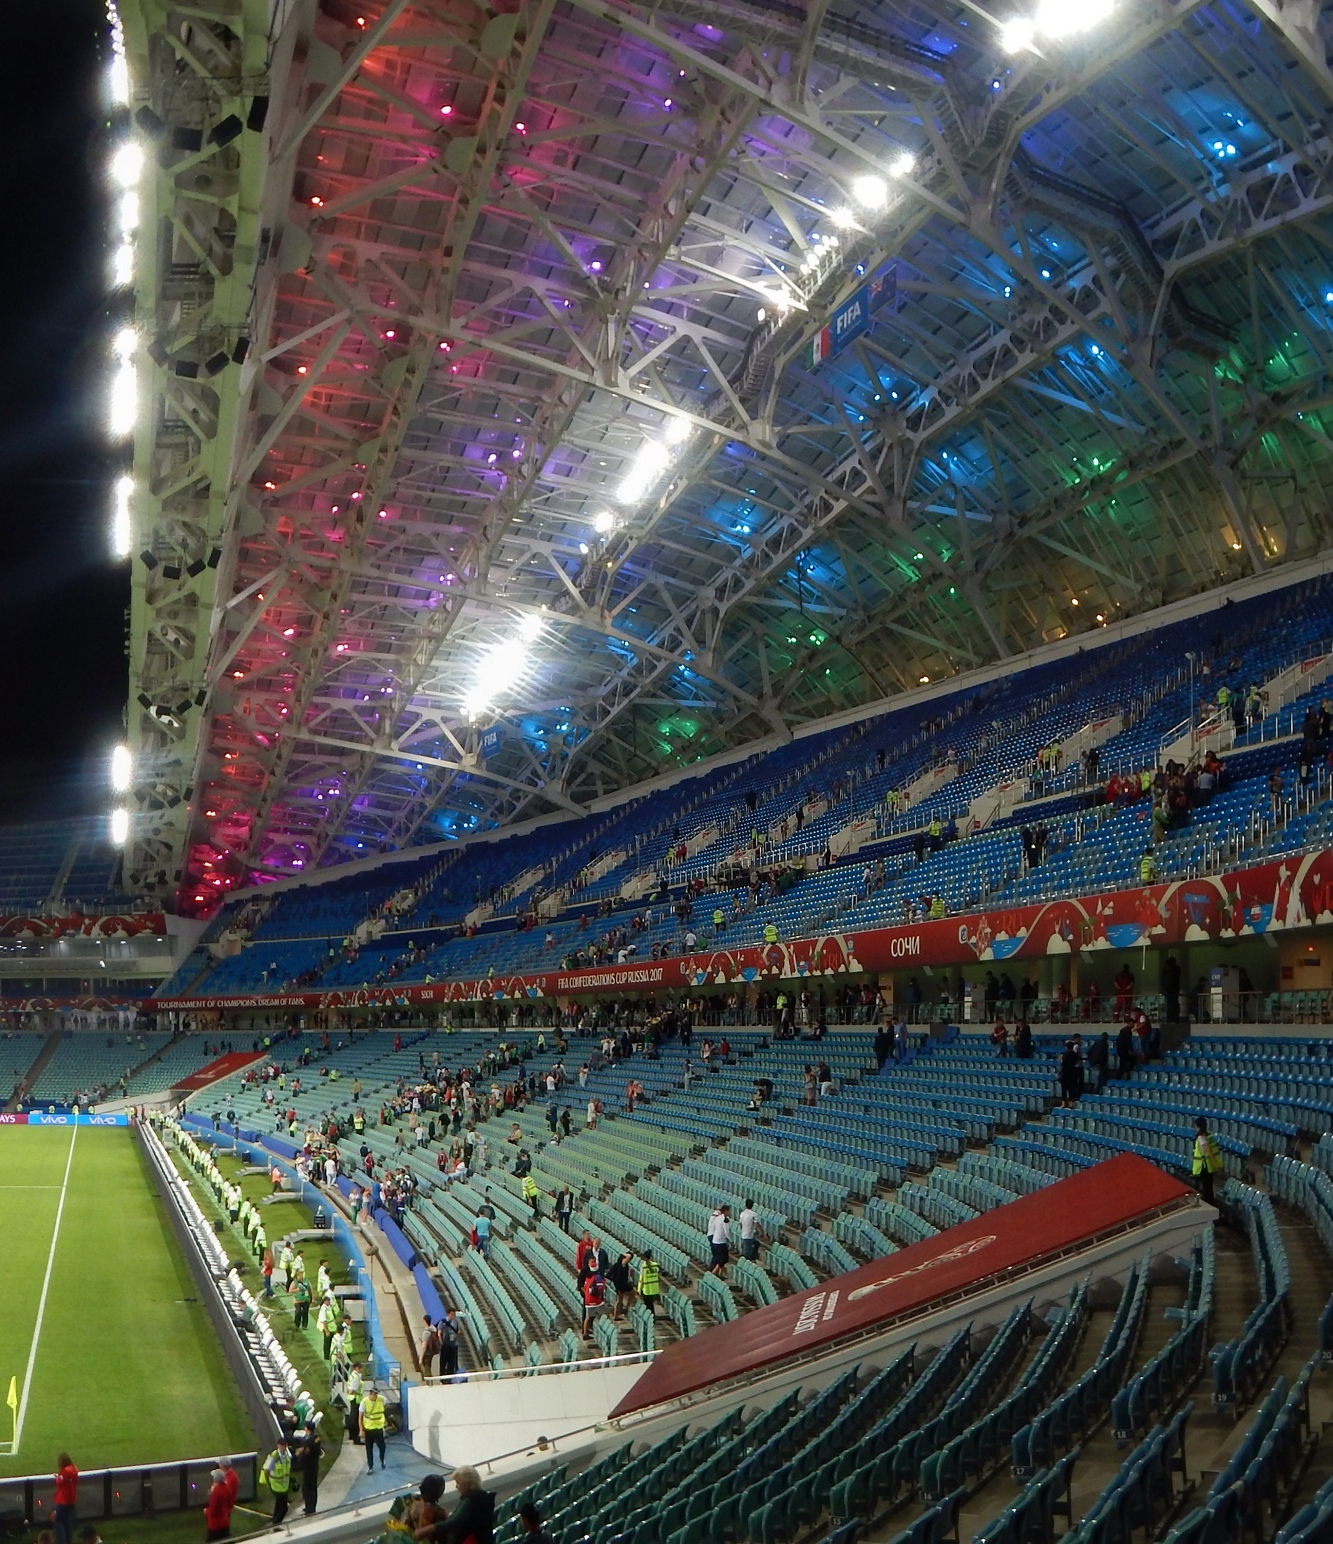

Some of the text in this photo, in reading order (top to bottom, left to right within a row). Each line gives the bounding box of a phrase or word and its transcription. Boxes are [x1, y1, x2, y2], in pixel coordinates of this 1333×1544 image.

[836, 301, 862, 335] FIFA
[890, 935, 920, 957] СОЧИ
[616, 971, 628, 985] CUP
[649, 968, 663, 981] 2017
